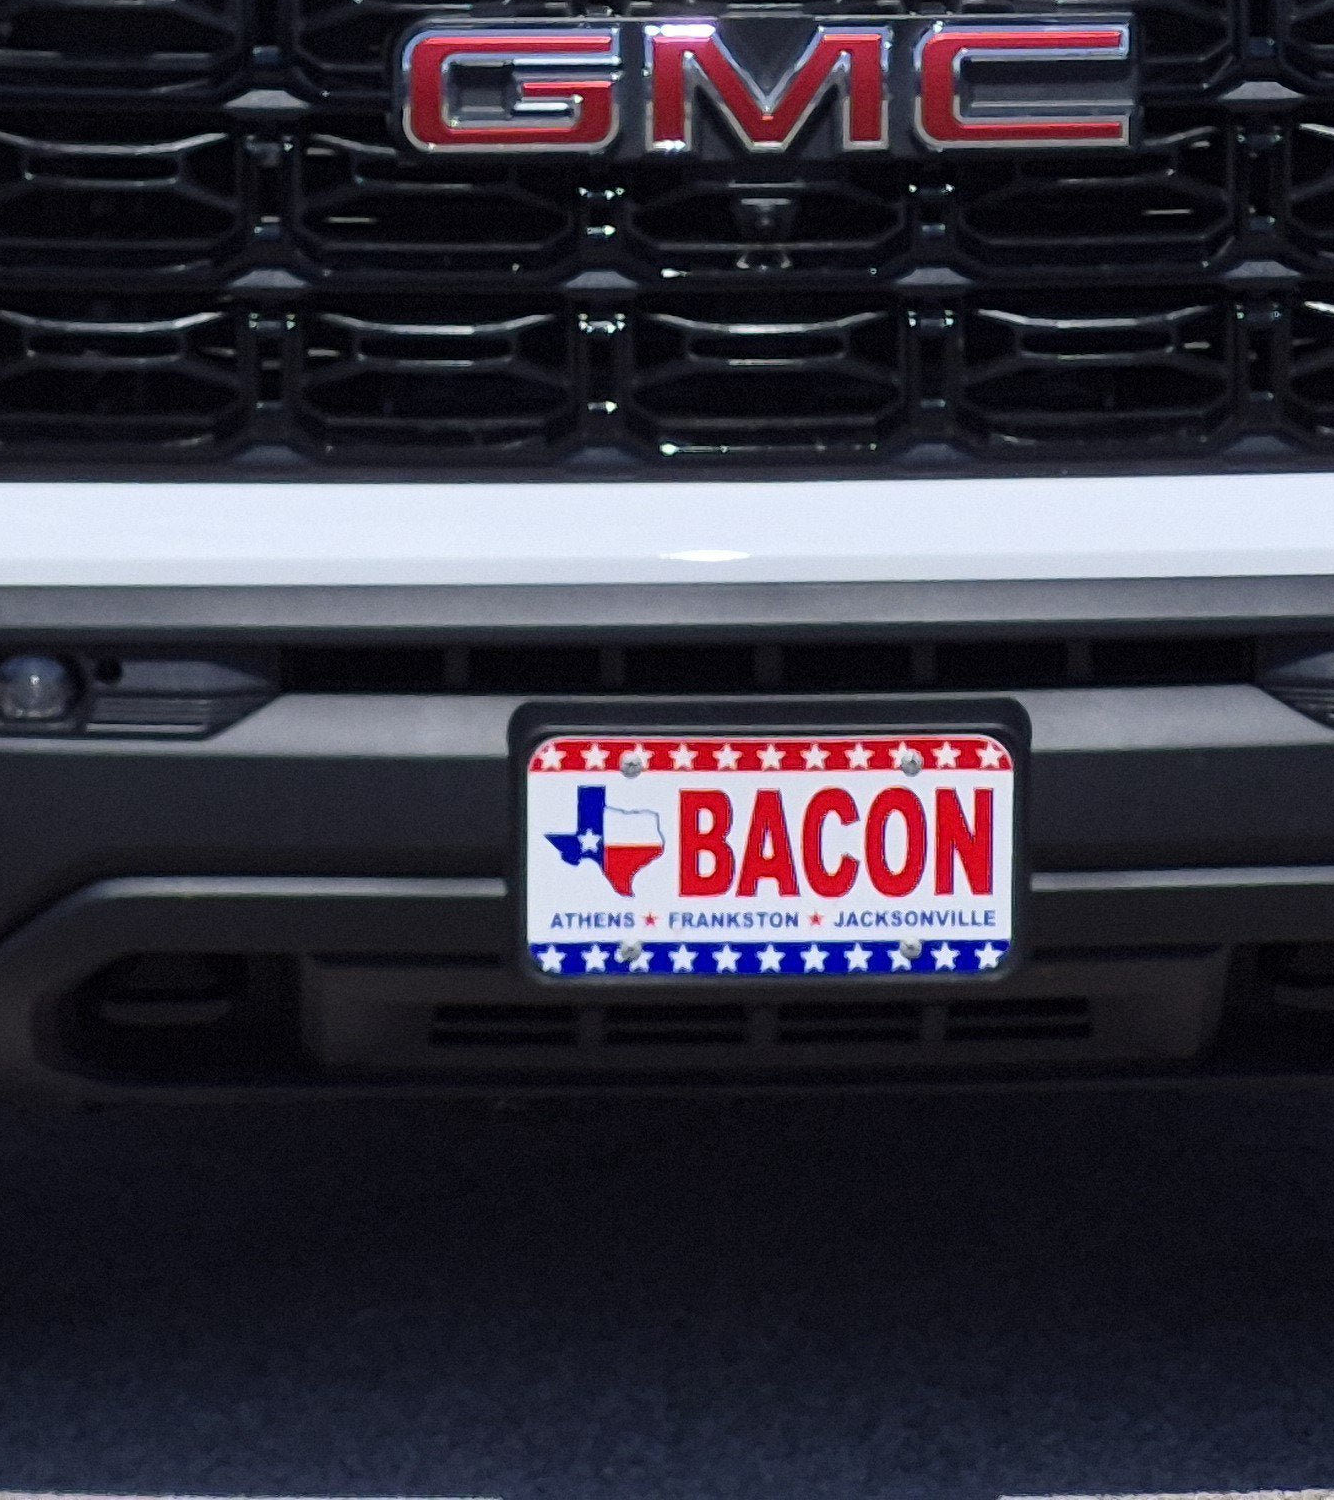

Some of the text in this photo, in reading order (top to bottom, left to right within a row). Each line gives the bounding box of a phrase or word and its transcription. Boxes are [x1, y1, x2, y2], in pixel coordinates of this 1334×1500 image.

[401, 22, 1132, 152] GMC
[677, 785, 994, 898] BACON
[550, 909, 997, 930] ATHENS FRANKSTON JACKSONVILLE
